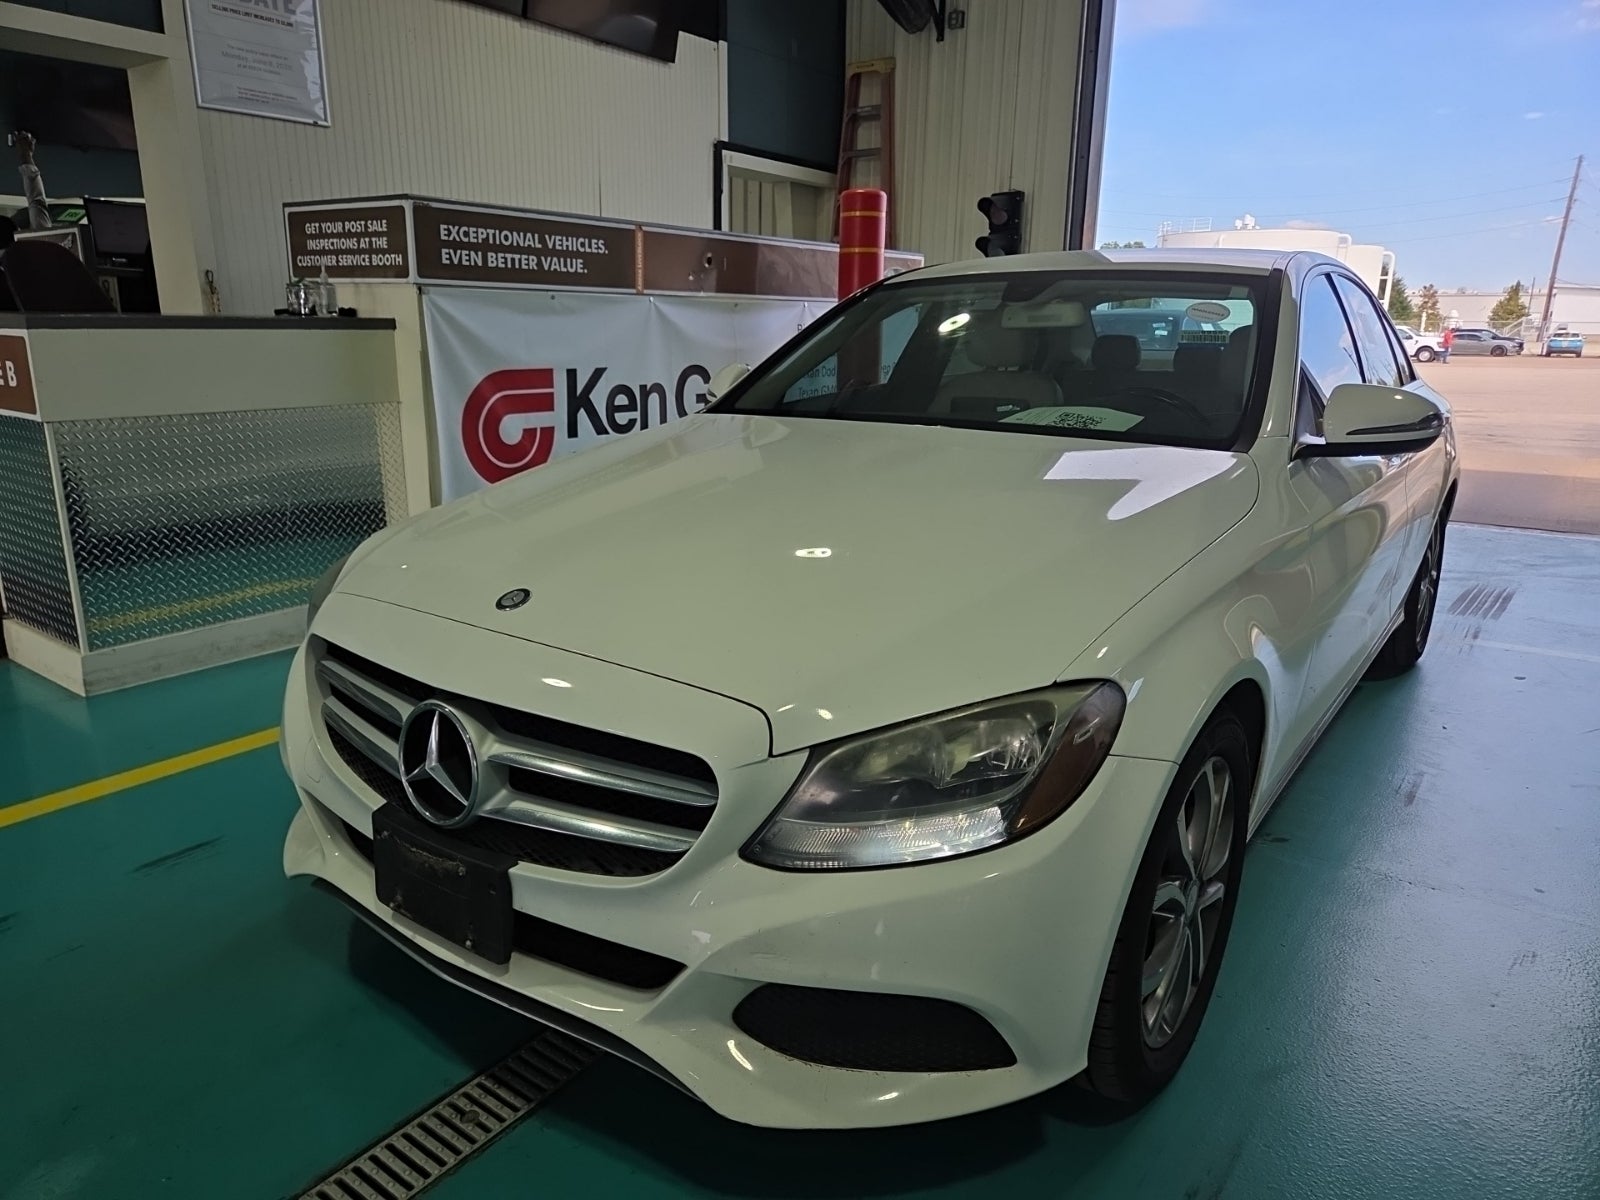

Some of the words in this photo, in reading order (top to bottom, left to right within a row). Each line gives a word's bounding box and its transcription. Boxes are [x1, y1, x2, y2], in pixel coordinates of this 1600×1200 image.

[305, 222, 319, 234] GET
[320, 221, 343, 233] YOUR
[344, 220, 365, 233] POST
[367, 219, 388, 232] SALE
[306, 238, 358, 250] INSPECTIONS
[359, 237, 370, 249] AT
[370, 237, 388, 249] THE
[439, 224, 542, 248] EXCEPTIONAL
[545, 234, 608, 254] VEHICLES.
[296, 254, 337, 267] CUSTOMER
[338, 254, 370, 266] SERVICE
[371, 253, 403, 266] BOOTH
[441, 248, 483, 267] EVEN
[487, 252, 538, 270] BETTER
[541, 256, 588, 274] VALUE.
[565, 366, 668, 439] Ken
